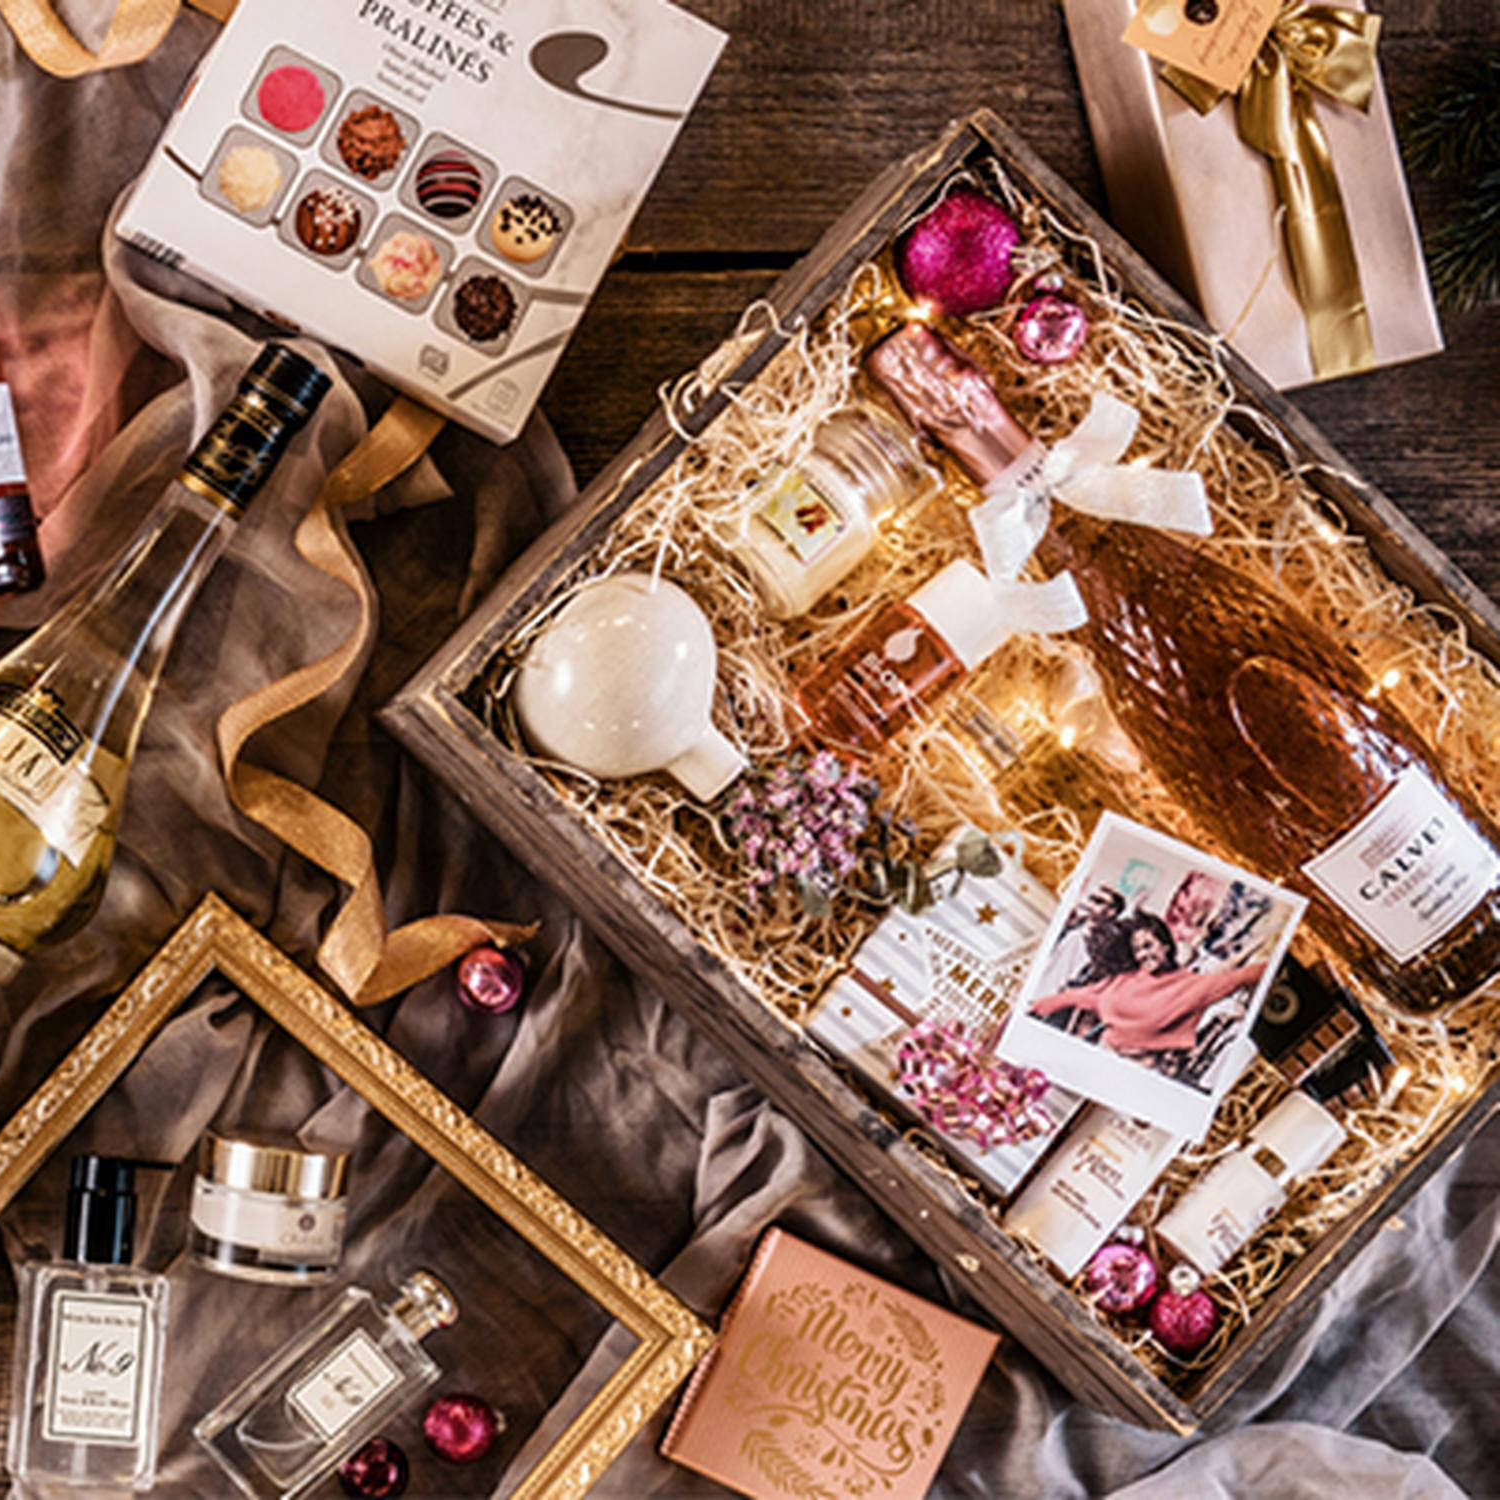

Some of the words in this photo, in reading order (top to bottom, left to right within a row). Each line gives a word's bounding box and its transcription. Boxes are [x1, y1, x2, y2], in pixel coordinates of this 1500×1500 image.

[1360, 817, 1446, 901] CALVET
[948, 962, 1010, 1021] MERR
[739, 1330, 914, 1472] Christmas
[798, 1300, 910, 1407] Merry
